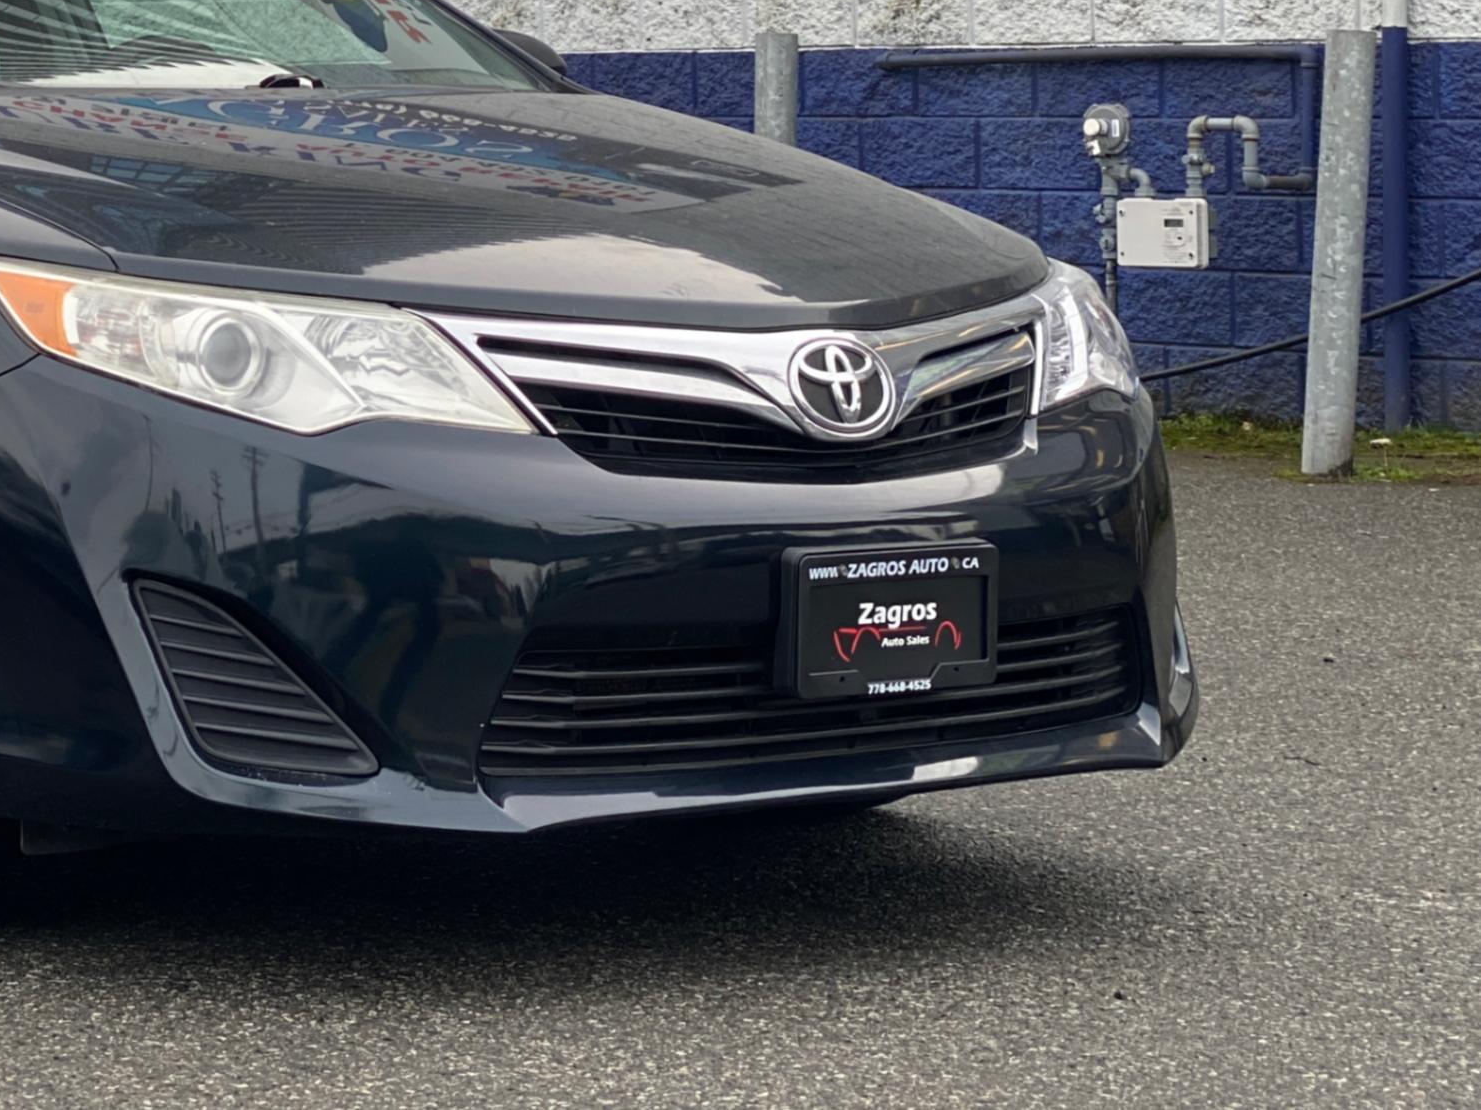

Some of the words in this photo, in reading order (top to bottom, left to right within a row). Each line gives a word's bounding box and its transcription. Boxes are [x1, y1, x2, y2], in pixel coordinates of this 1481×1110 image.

[847, 560, 906, 579] ZAGROS
[908, 557, 949, 574] AUTO
[962, 557, 979, 569] CA
[857, 602, 937, 629] Zagros
[881, 637, 905, 647] Auto
[906, 635, 930, 646] Sales
[867, 680, 931, 694] 778-668-4525
